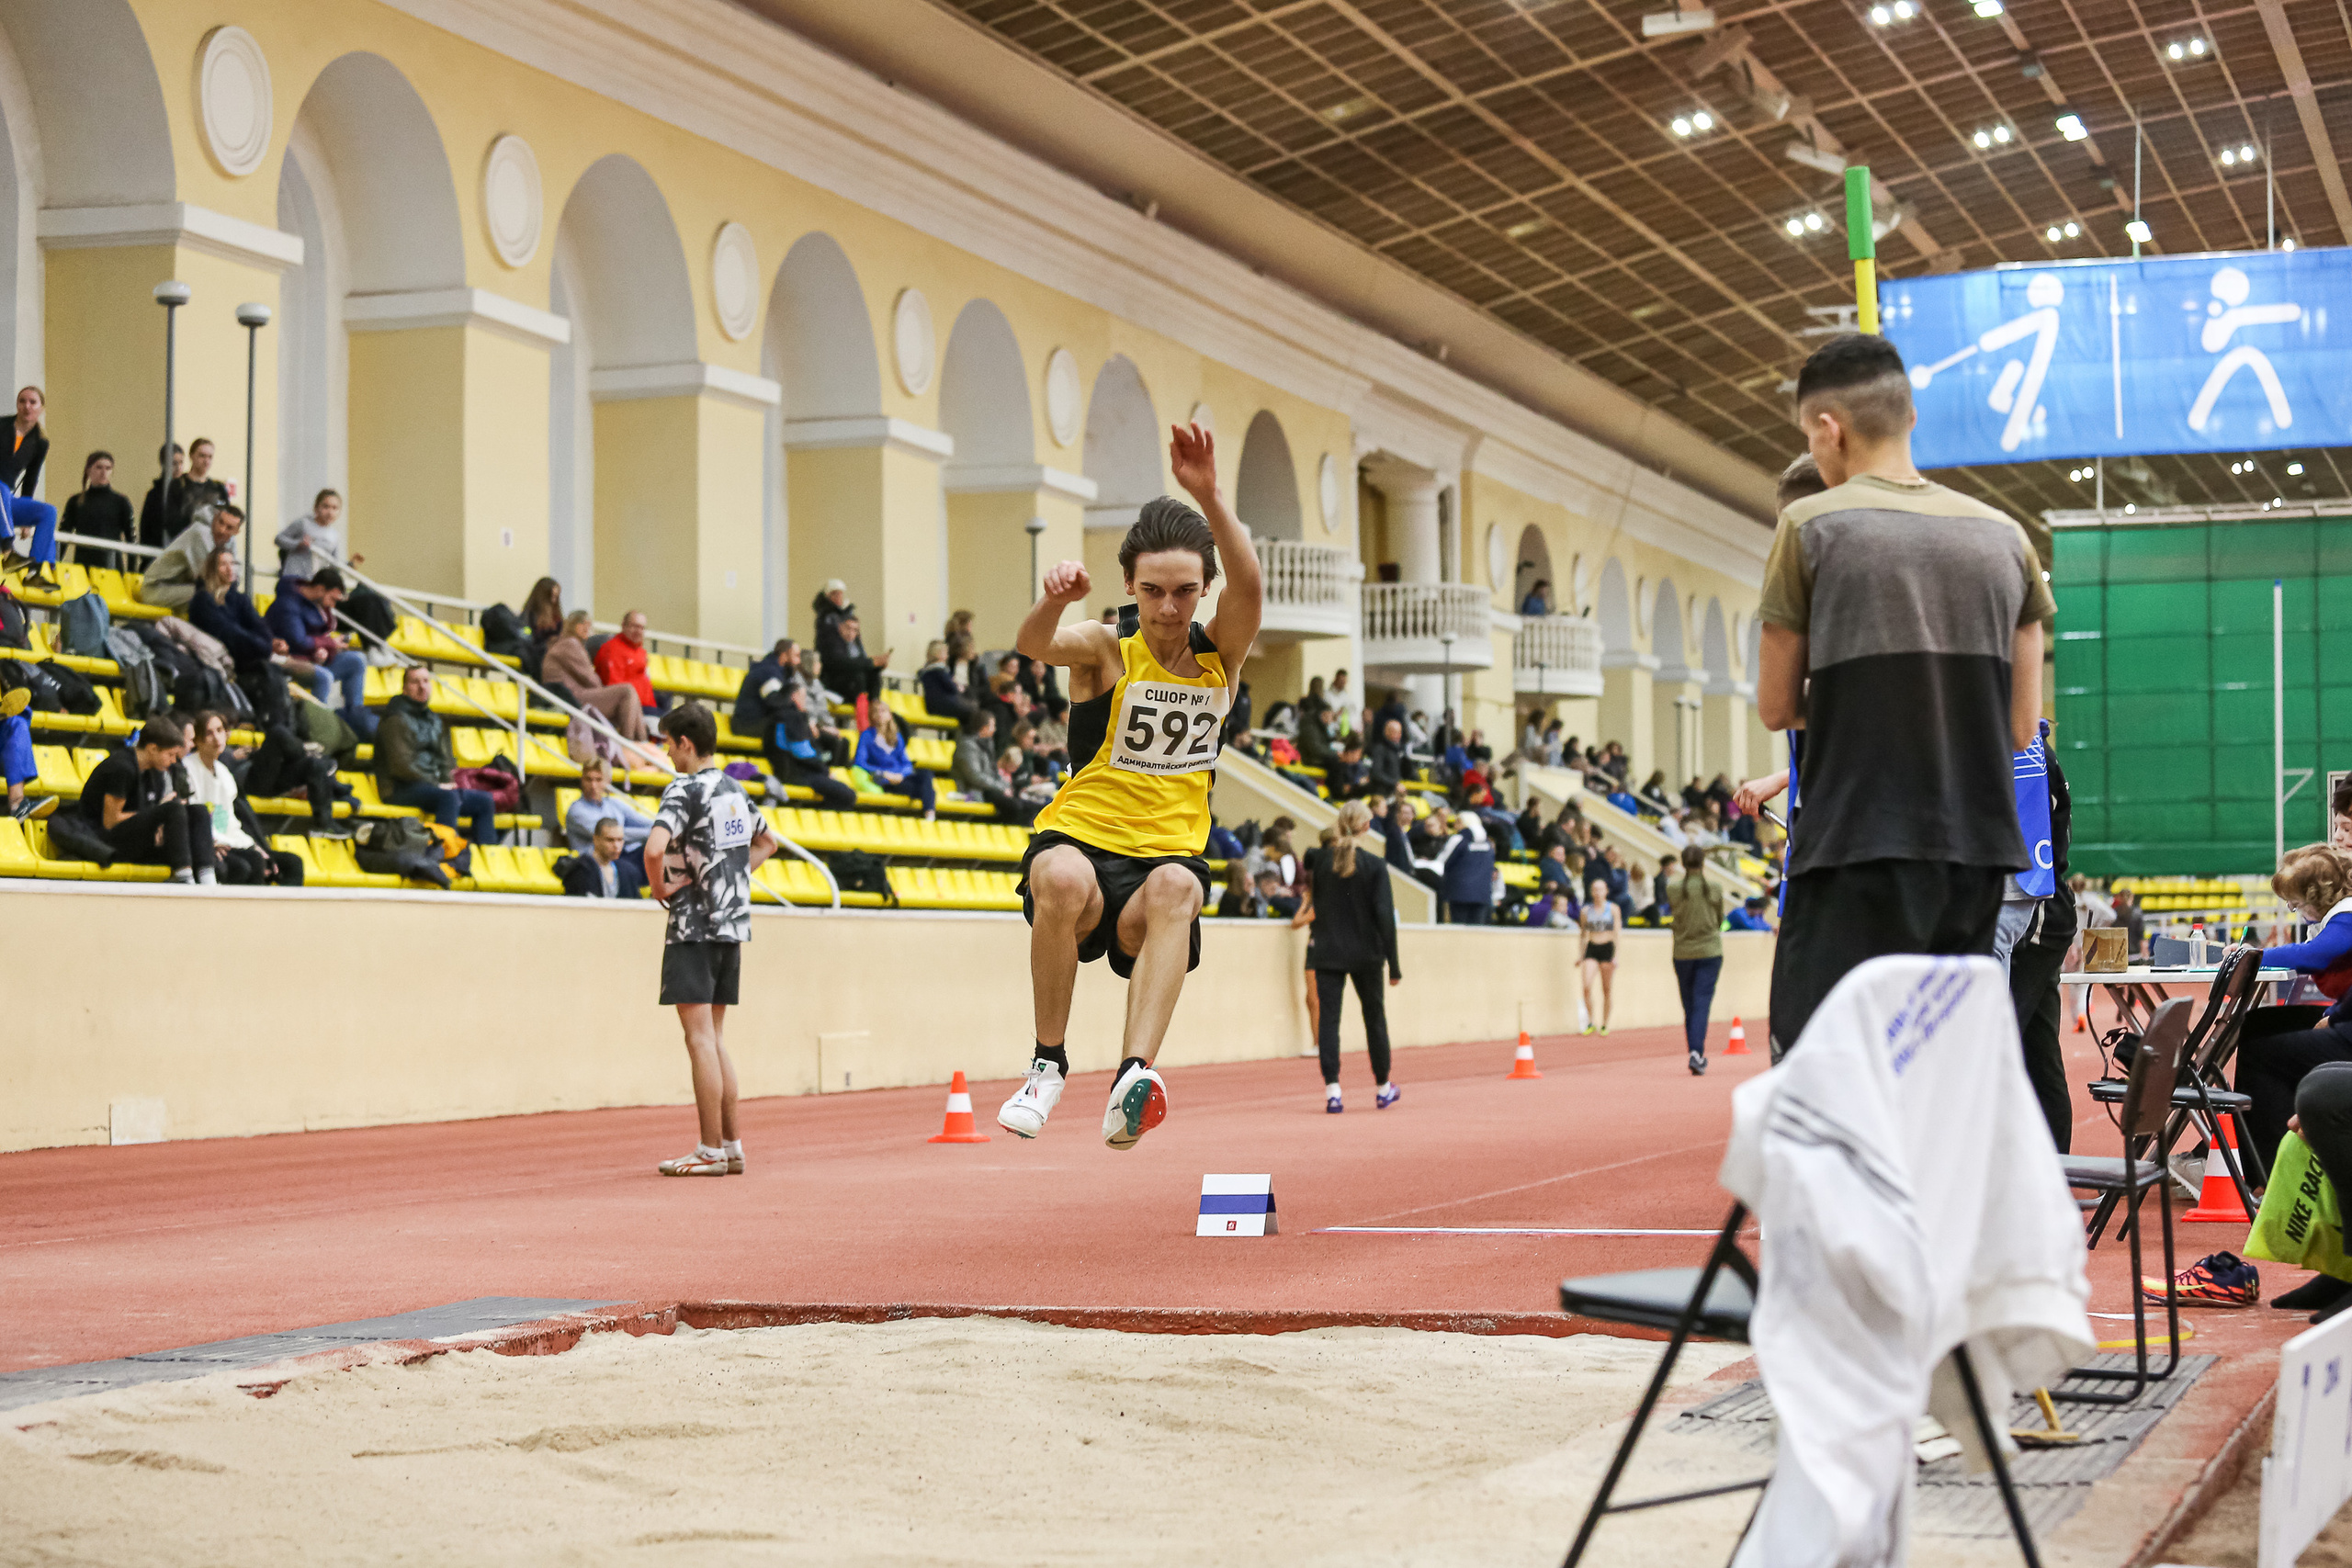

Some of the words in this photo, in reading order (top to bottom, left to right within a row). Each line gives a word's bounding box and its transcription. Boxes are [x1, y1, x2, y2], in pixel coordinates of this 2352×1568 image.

[1145, 689, 1188, 705] СШОР
[1125, 705, 1218, 756] 592
[1117, 755, 1187, 770] Адмиралтейский
[724, 818, 744, 837] 956
[2285, 1197, 2313, 1245] NIKE
